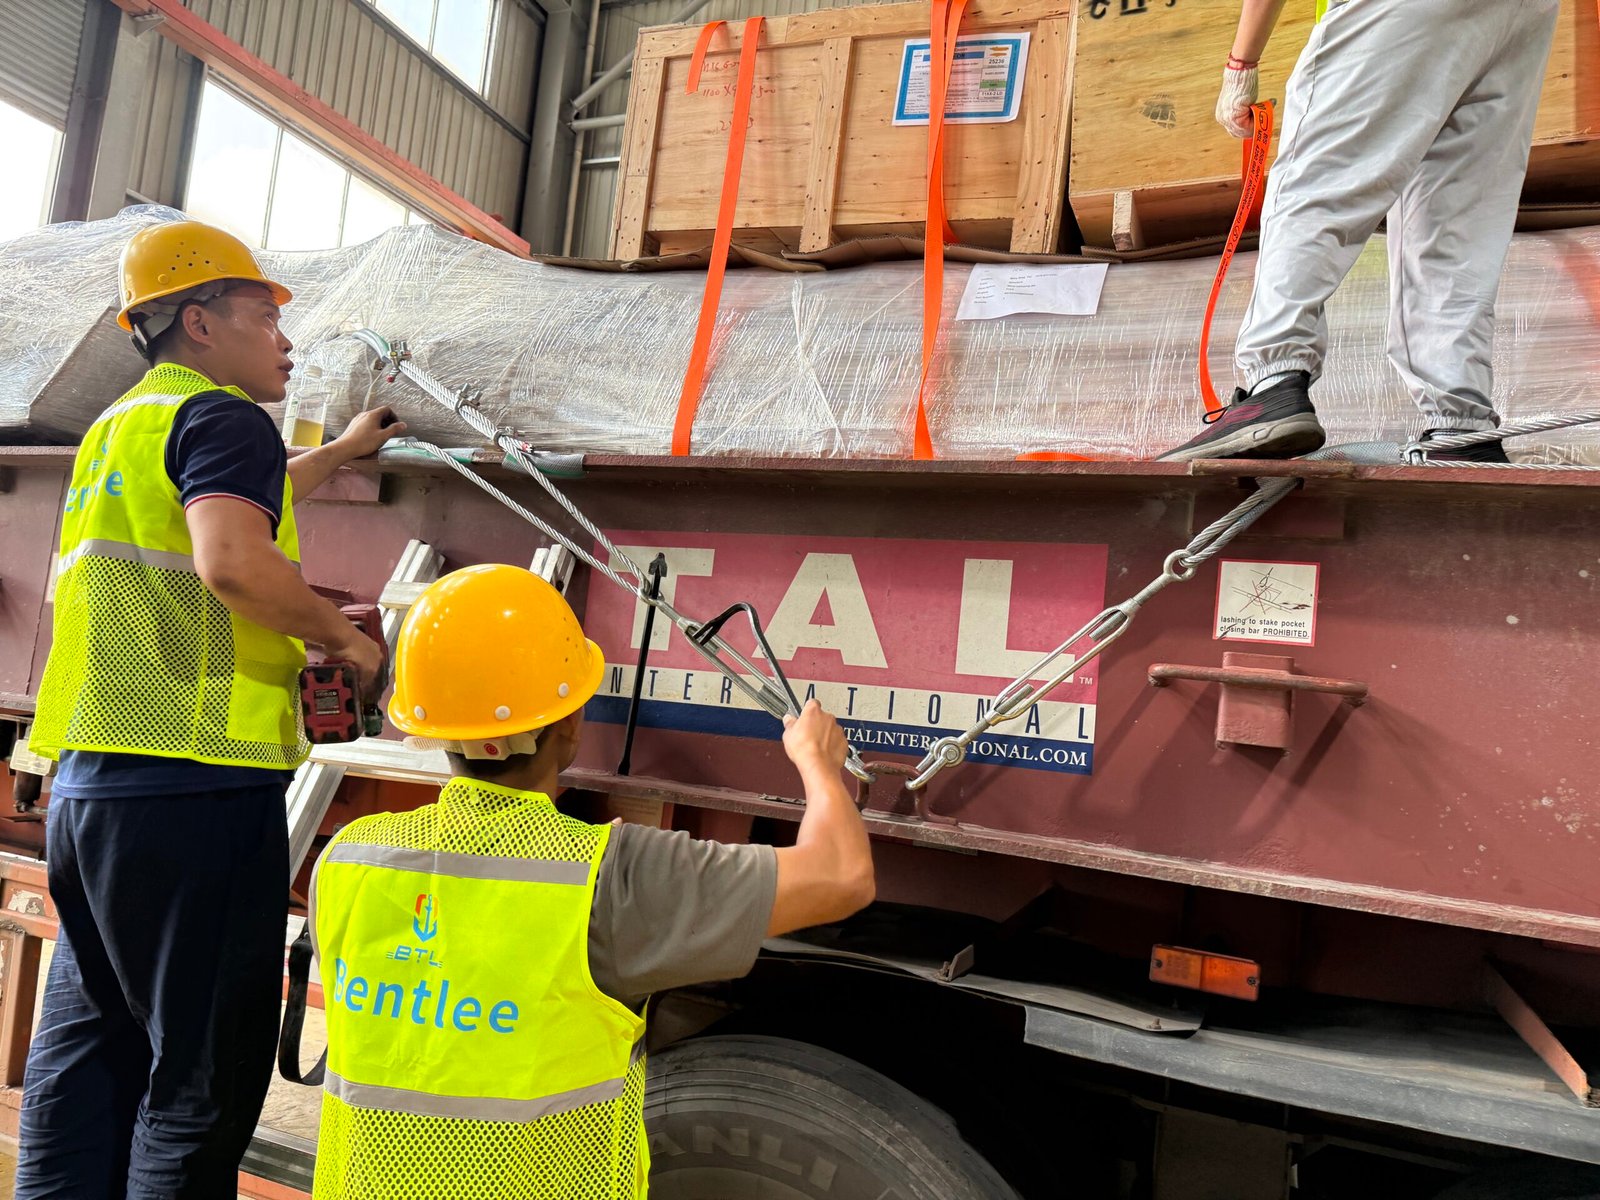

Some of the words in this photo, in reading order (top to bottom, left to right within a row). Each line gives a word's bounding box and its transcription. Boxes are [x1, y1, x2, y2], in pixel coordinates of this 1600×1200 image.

[608, 544, 1075, 684] TAL
[1219, 625, 1246, 635] closing
[1248, 626, 1260, 634] bar
[1262, 627, 1310, 639] PROHIBITED.
[1220, 615, 1246, 626] lashing
[1259, 618, 1279, 626] stake
[1281, 620, 1305, 628] pocket
[609, 666, 1090, 740] NTERATIONAL
[393, 944, 442, 968] BTL
[333, 957, 520, 1034] Bentlee
